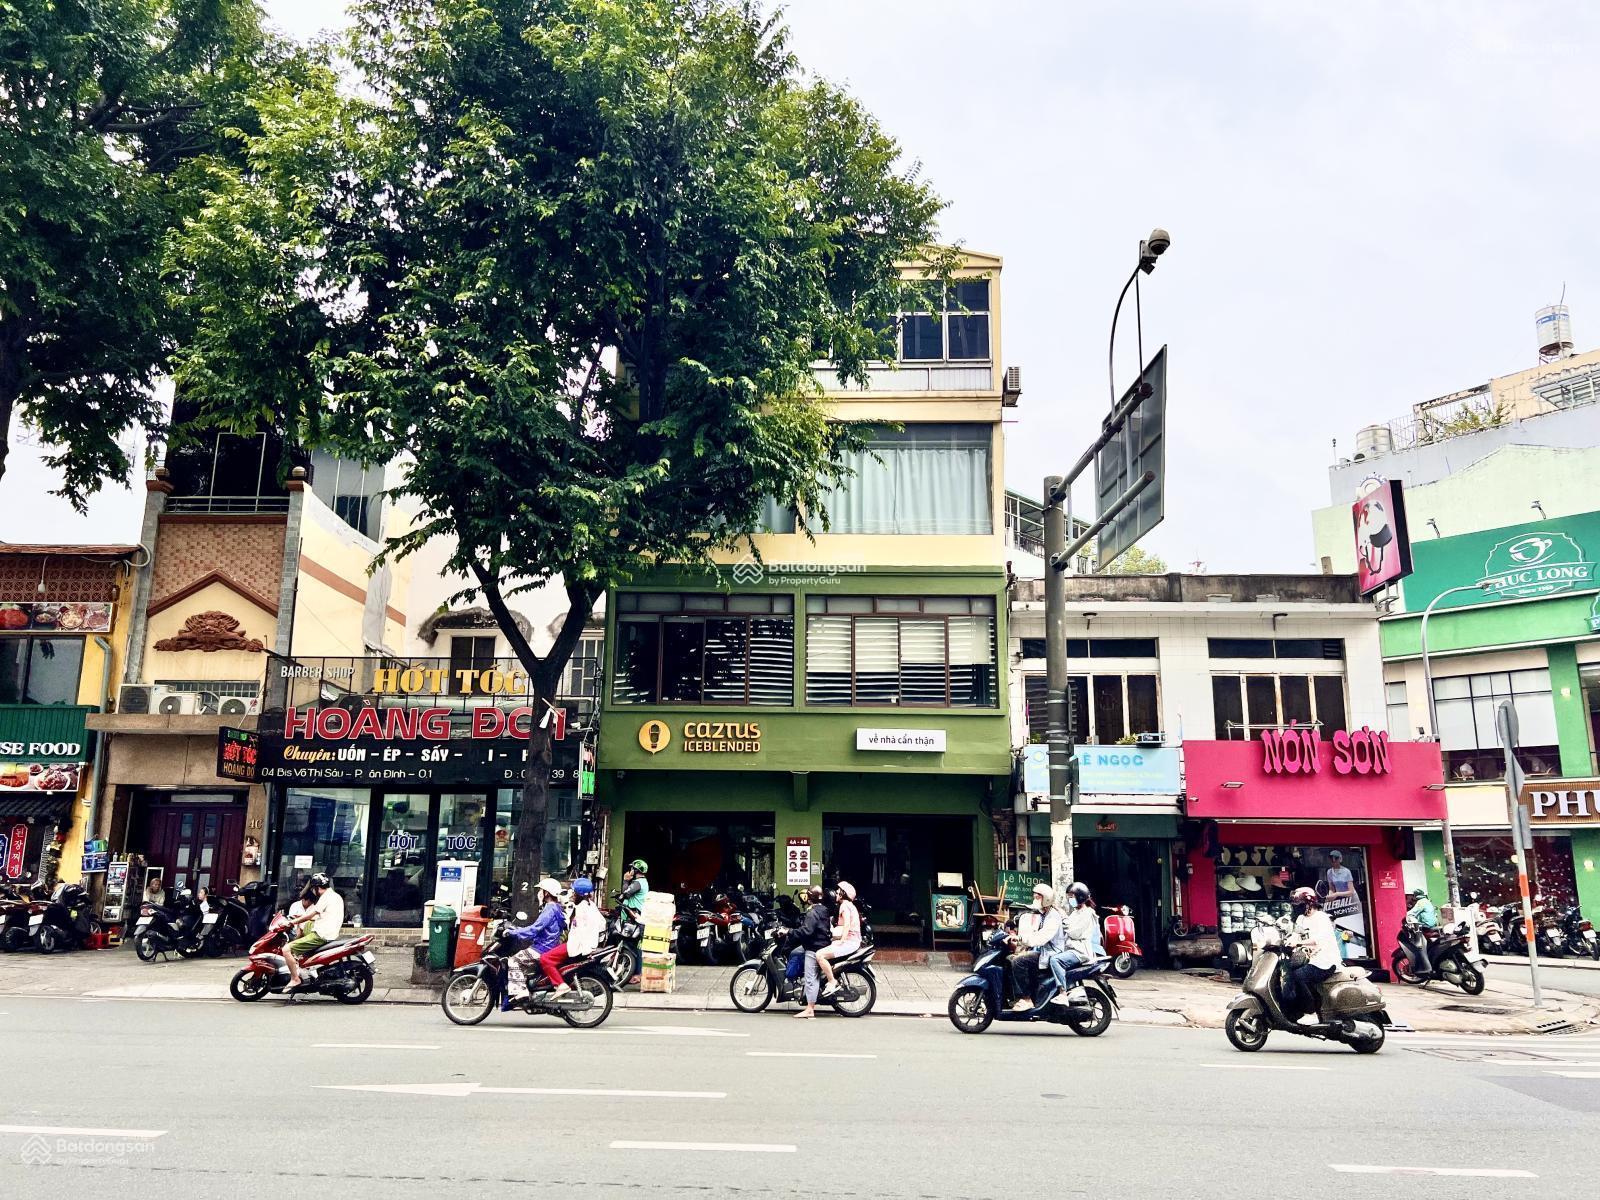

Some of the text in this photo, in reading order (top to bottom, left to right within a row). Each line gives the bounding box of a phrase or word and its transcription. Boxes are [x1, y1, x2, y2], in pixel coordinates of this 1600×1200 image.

[1536, 566, 1588, 581] LONG
[281, 665, 356, 679] BARBER SHOP
[455, 664, 528, 694] TÓC
[284, 700, 453, 740] HOÀNG
[28, 742, 80, 756] FOOD
[337, 744, 367, 761] UỐN
[383, 746, 402, 762] ÉP
[421, 745, 450, 762] SẤY
[684, 740, 761, 752] ICEBLENDED
[276, 768, 293, 778] Bis
[521, 881, 529, 891] 2
